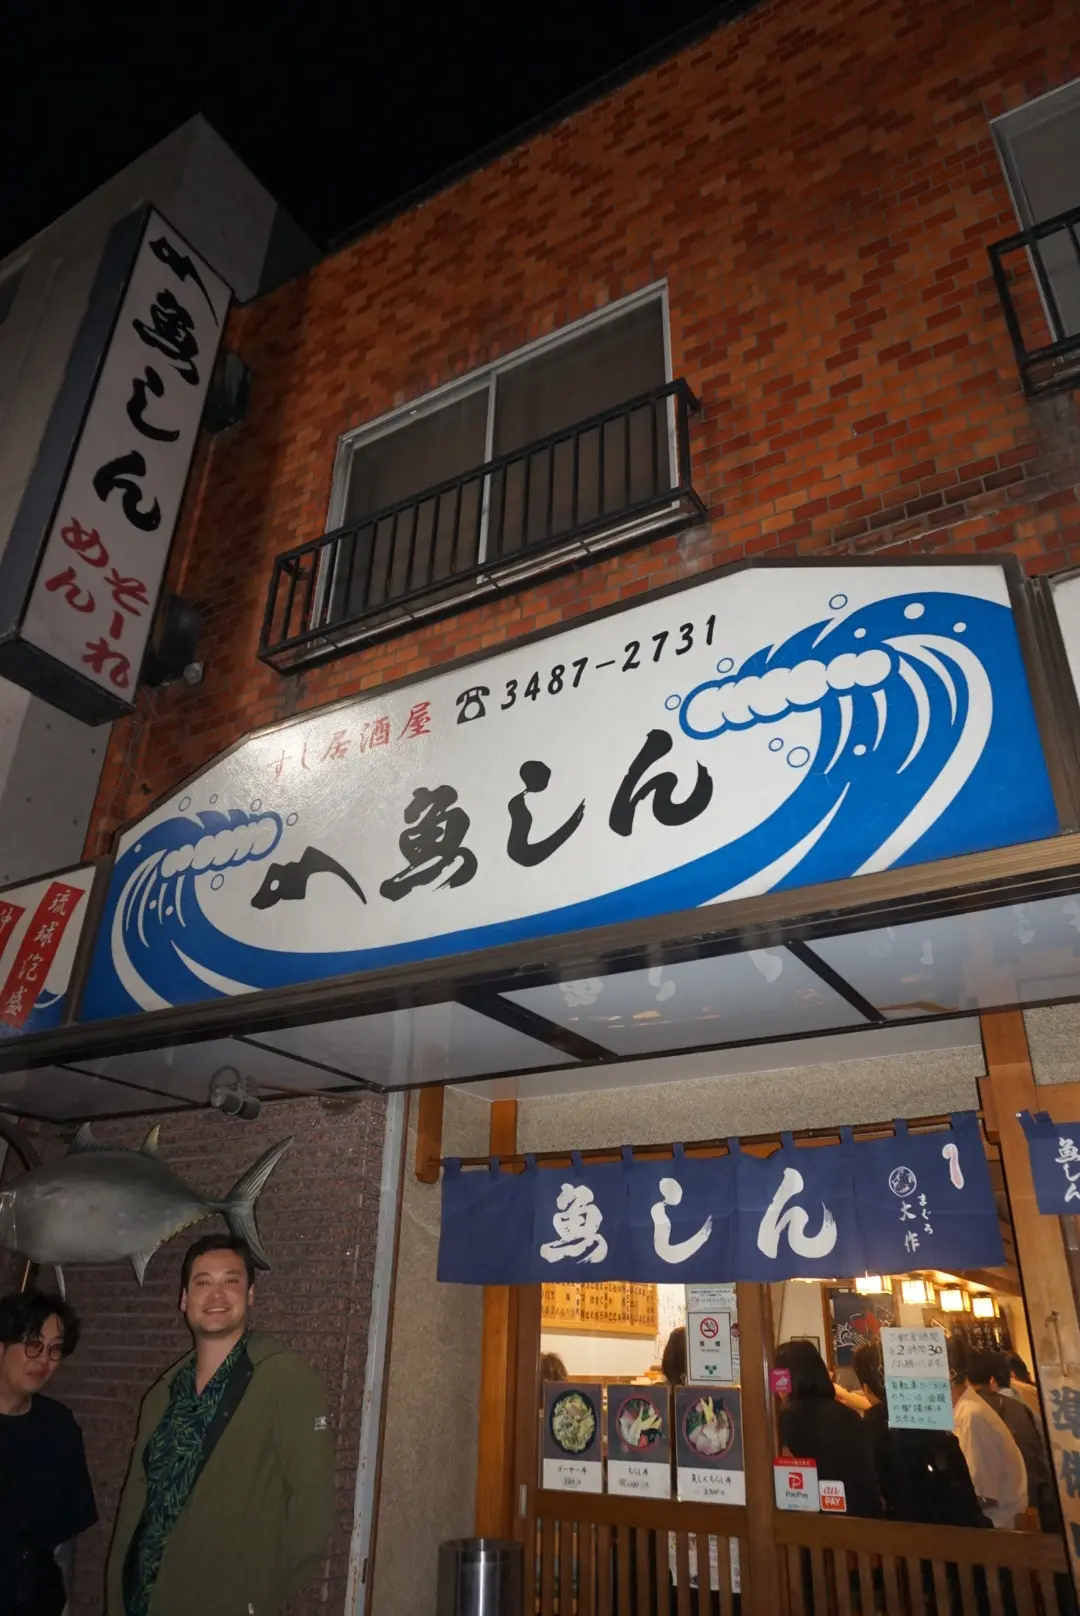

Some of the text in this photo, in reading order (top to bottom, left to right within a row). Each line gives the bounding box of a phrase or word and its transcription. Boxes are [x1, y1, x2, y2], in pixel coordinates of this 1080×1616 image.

[501, 614, 717, 711] 3487-2731
[267, 700, 432, 780] すし居酒屋
[5, 888, 71, 1017] 琉球泡盛
[540, 1167, 838, 1265] 魚しん
[917, 1193, 934, 1235] まぐろ
[825, 1497, 841, 1506] PAY
